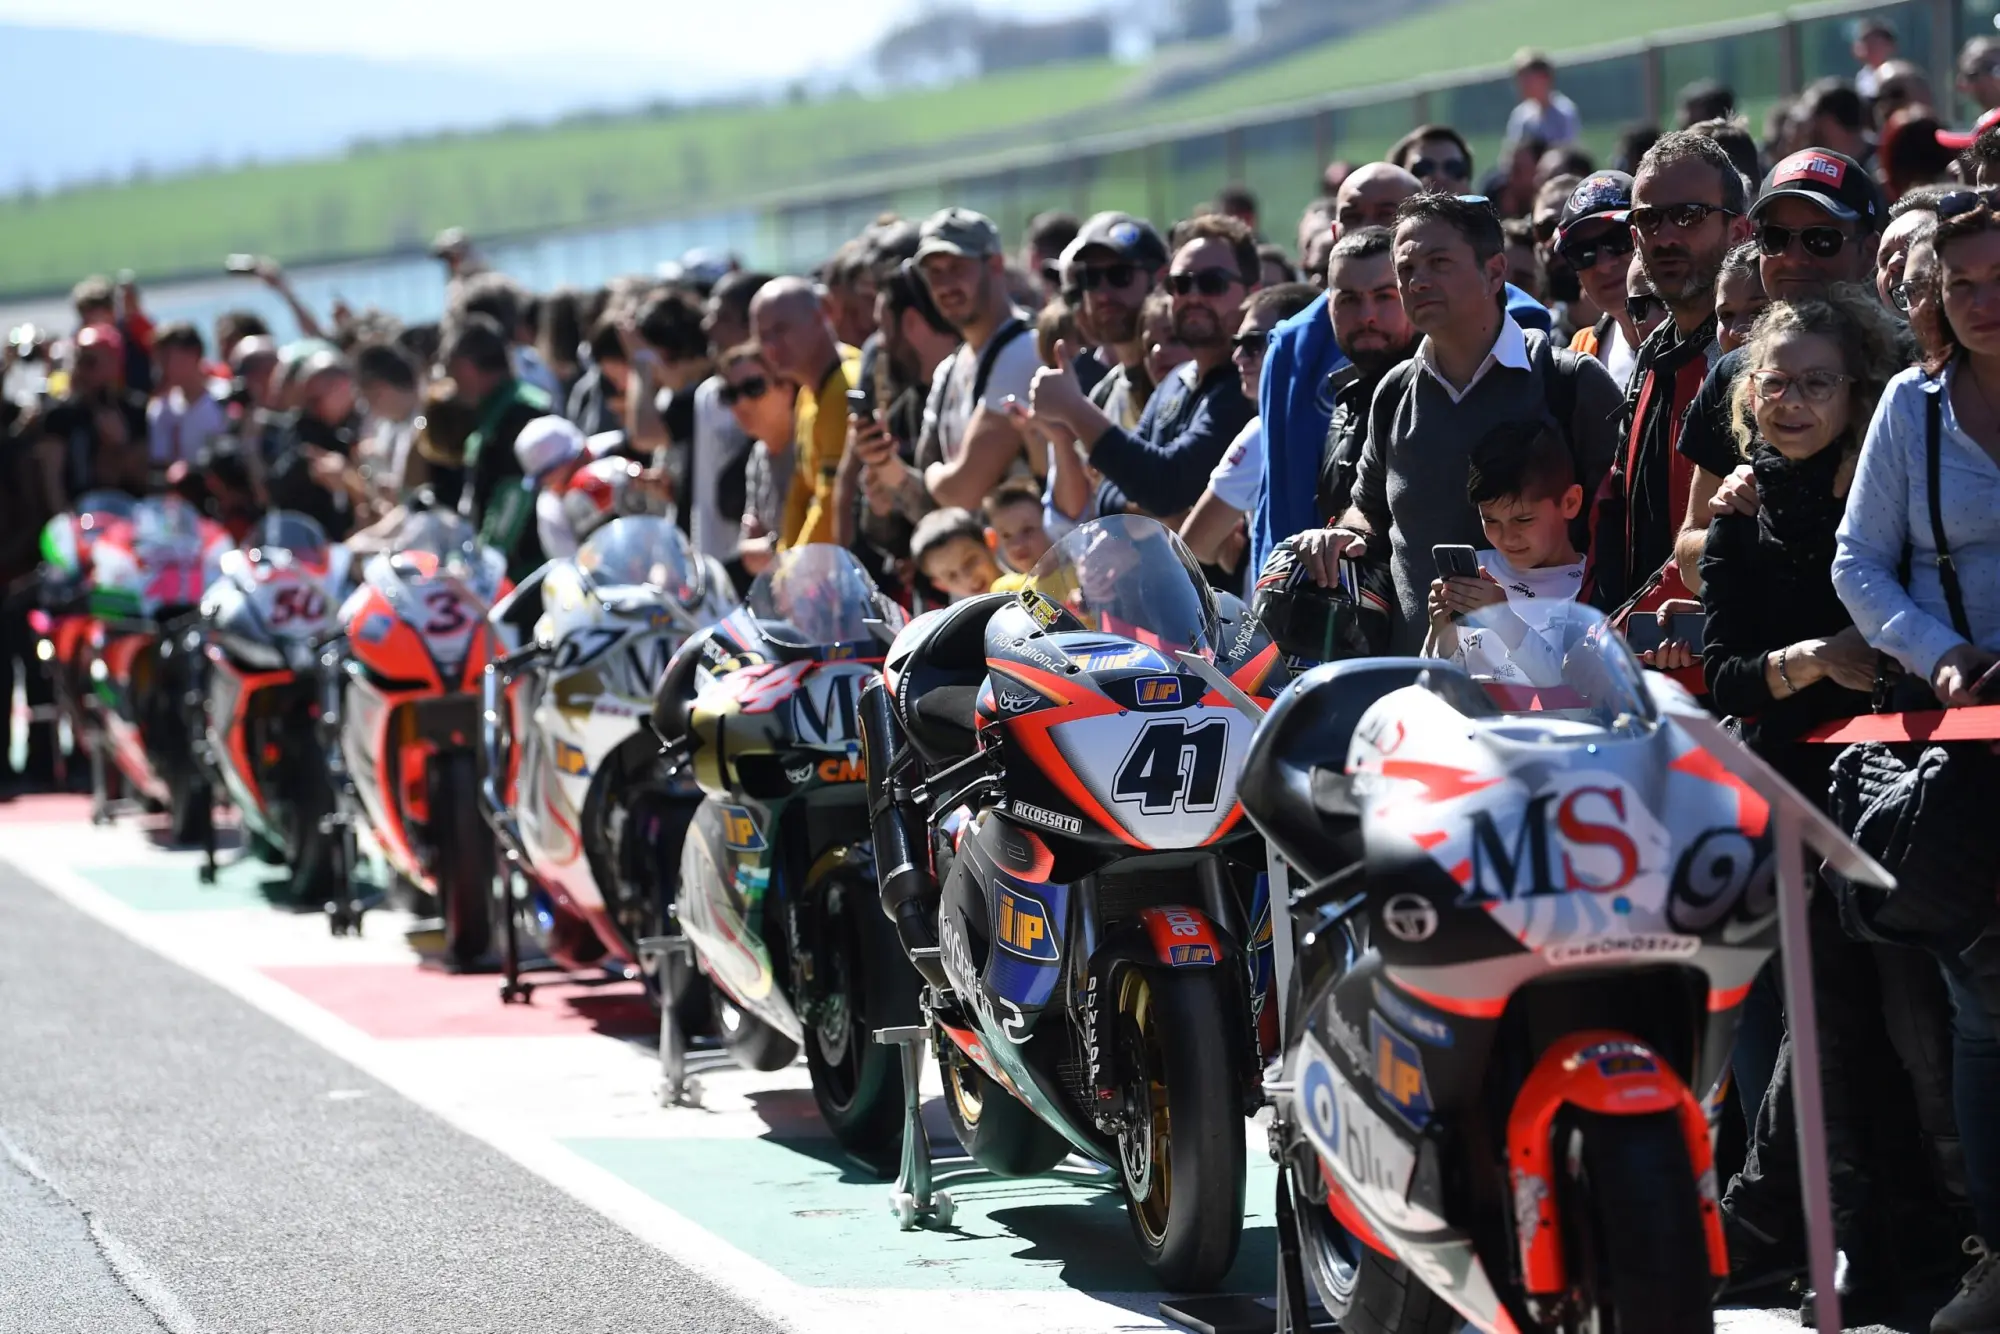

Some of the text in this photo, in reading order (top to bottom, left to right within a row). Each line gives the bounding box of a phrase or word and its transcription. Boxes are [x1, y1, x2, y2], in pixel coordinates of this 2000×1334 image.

[1780, 156, 1838, 178] aprilia
[424, 591, 471, 635] 3
[1113, 718, 1230, 816] 41
[1014, 803, 1081, 833] ACCOSSATO
[1455, 785, 1639, 906] MS
[1087, 976, 1099, 1079] DUNLOP
